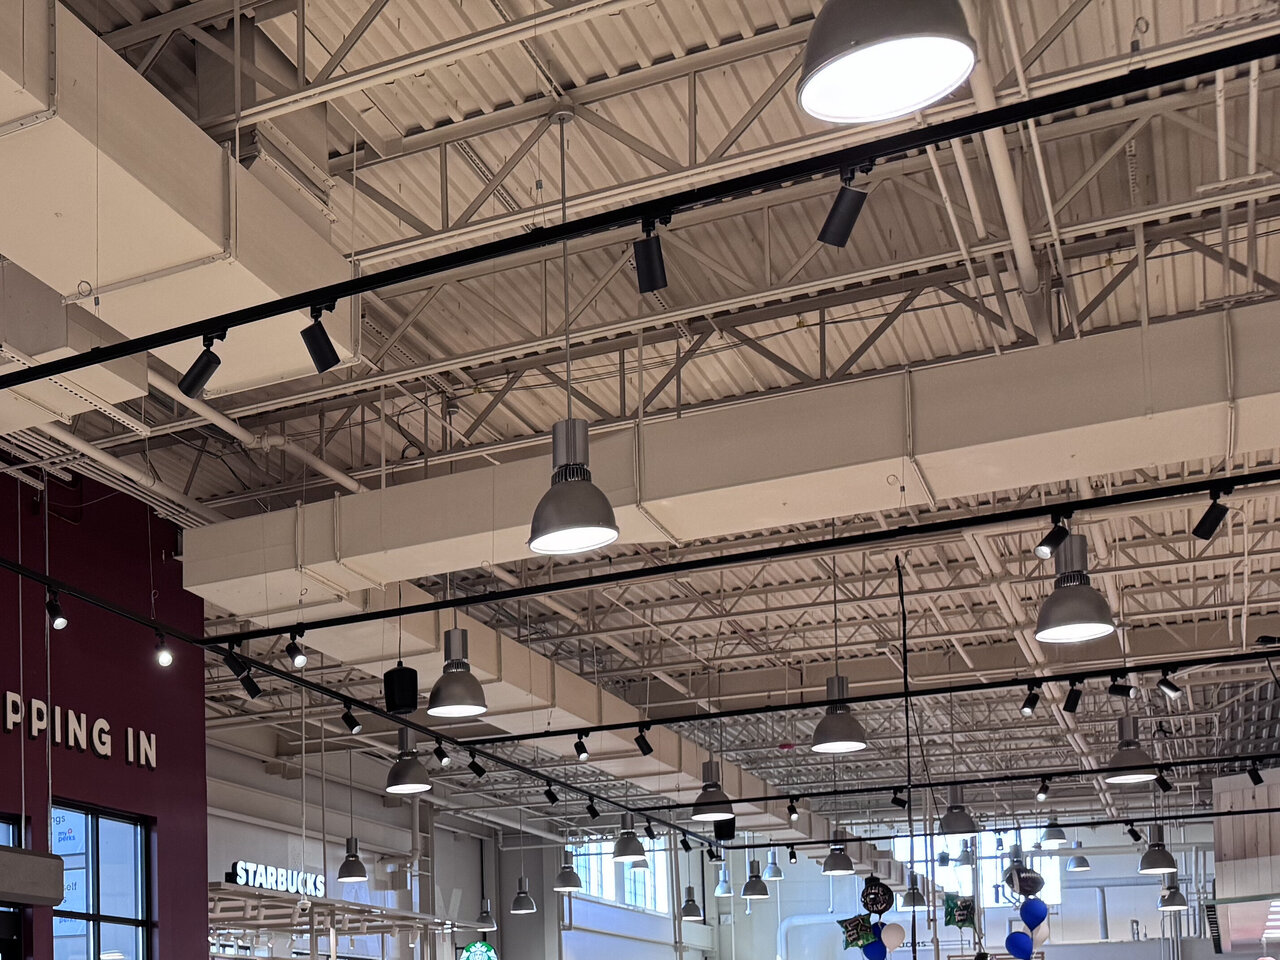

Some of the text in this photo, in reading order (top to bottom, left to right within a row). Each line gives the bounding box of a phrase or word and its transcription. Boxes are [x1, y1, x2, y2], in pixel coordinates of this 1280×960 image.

[126, 726, 157, 769] IN
[58, 834, 76, 843] perks
[236, 860, 325, 898] STARBUCKS
